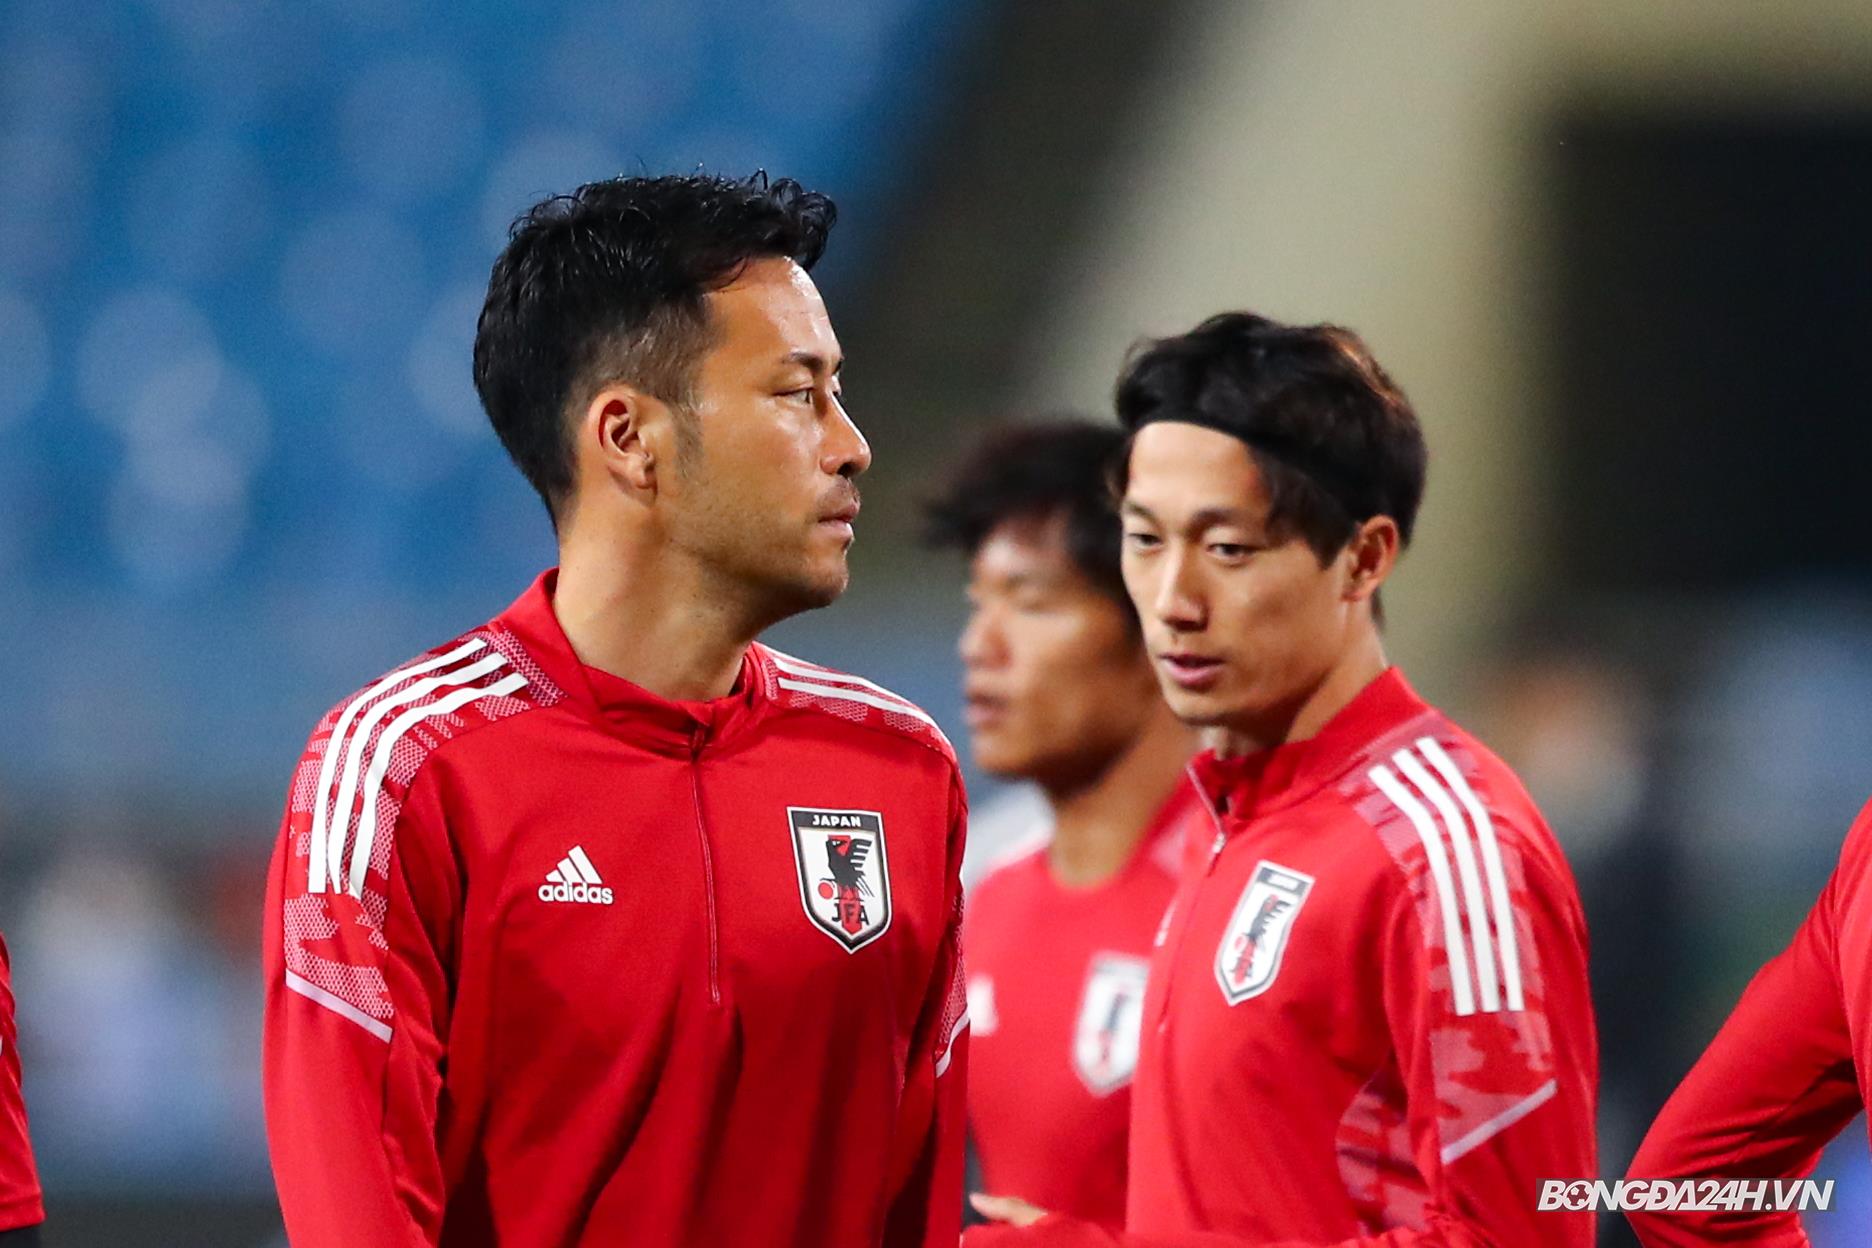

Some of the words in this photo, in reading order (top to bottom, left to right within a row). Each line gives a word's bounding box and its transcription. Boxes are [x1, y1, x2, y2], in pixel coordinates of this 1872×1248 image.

[812, 814, 861, 827] JAPAN
[537, 880, 614, 905] adidas
[831, 903, 870, 926] JFA
